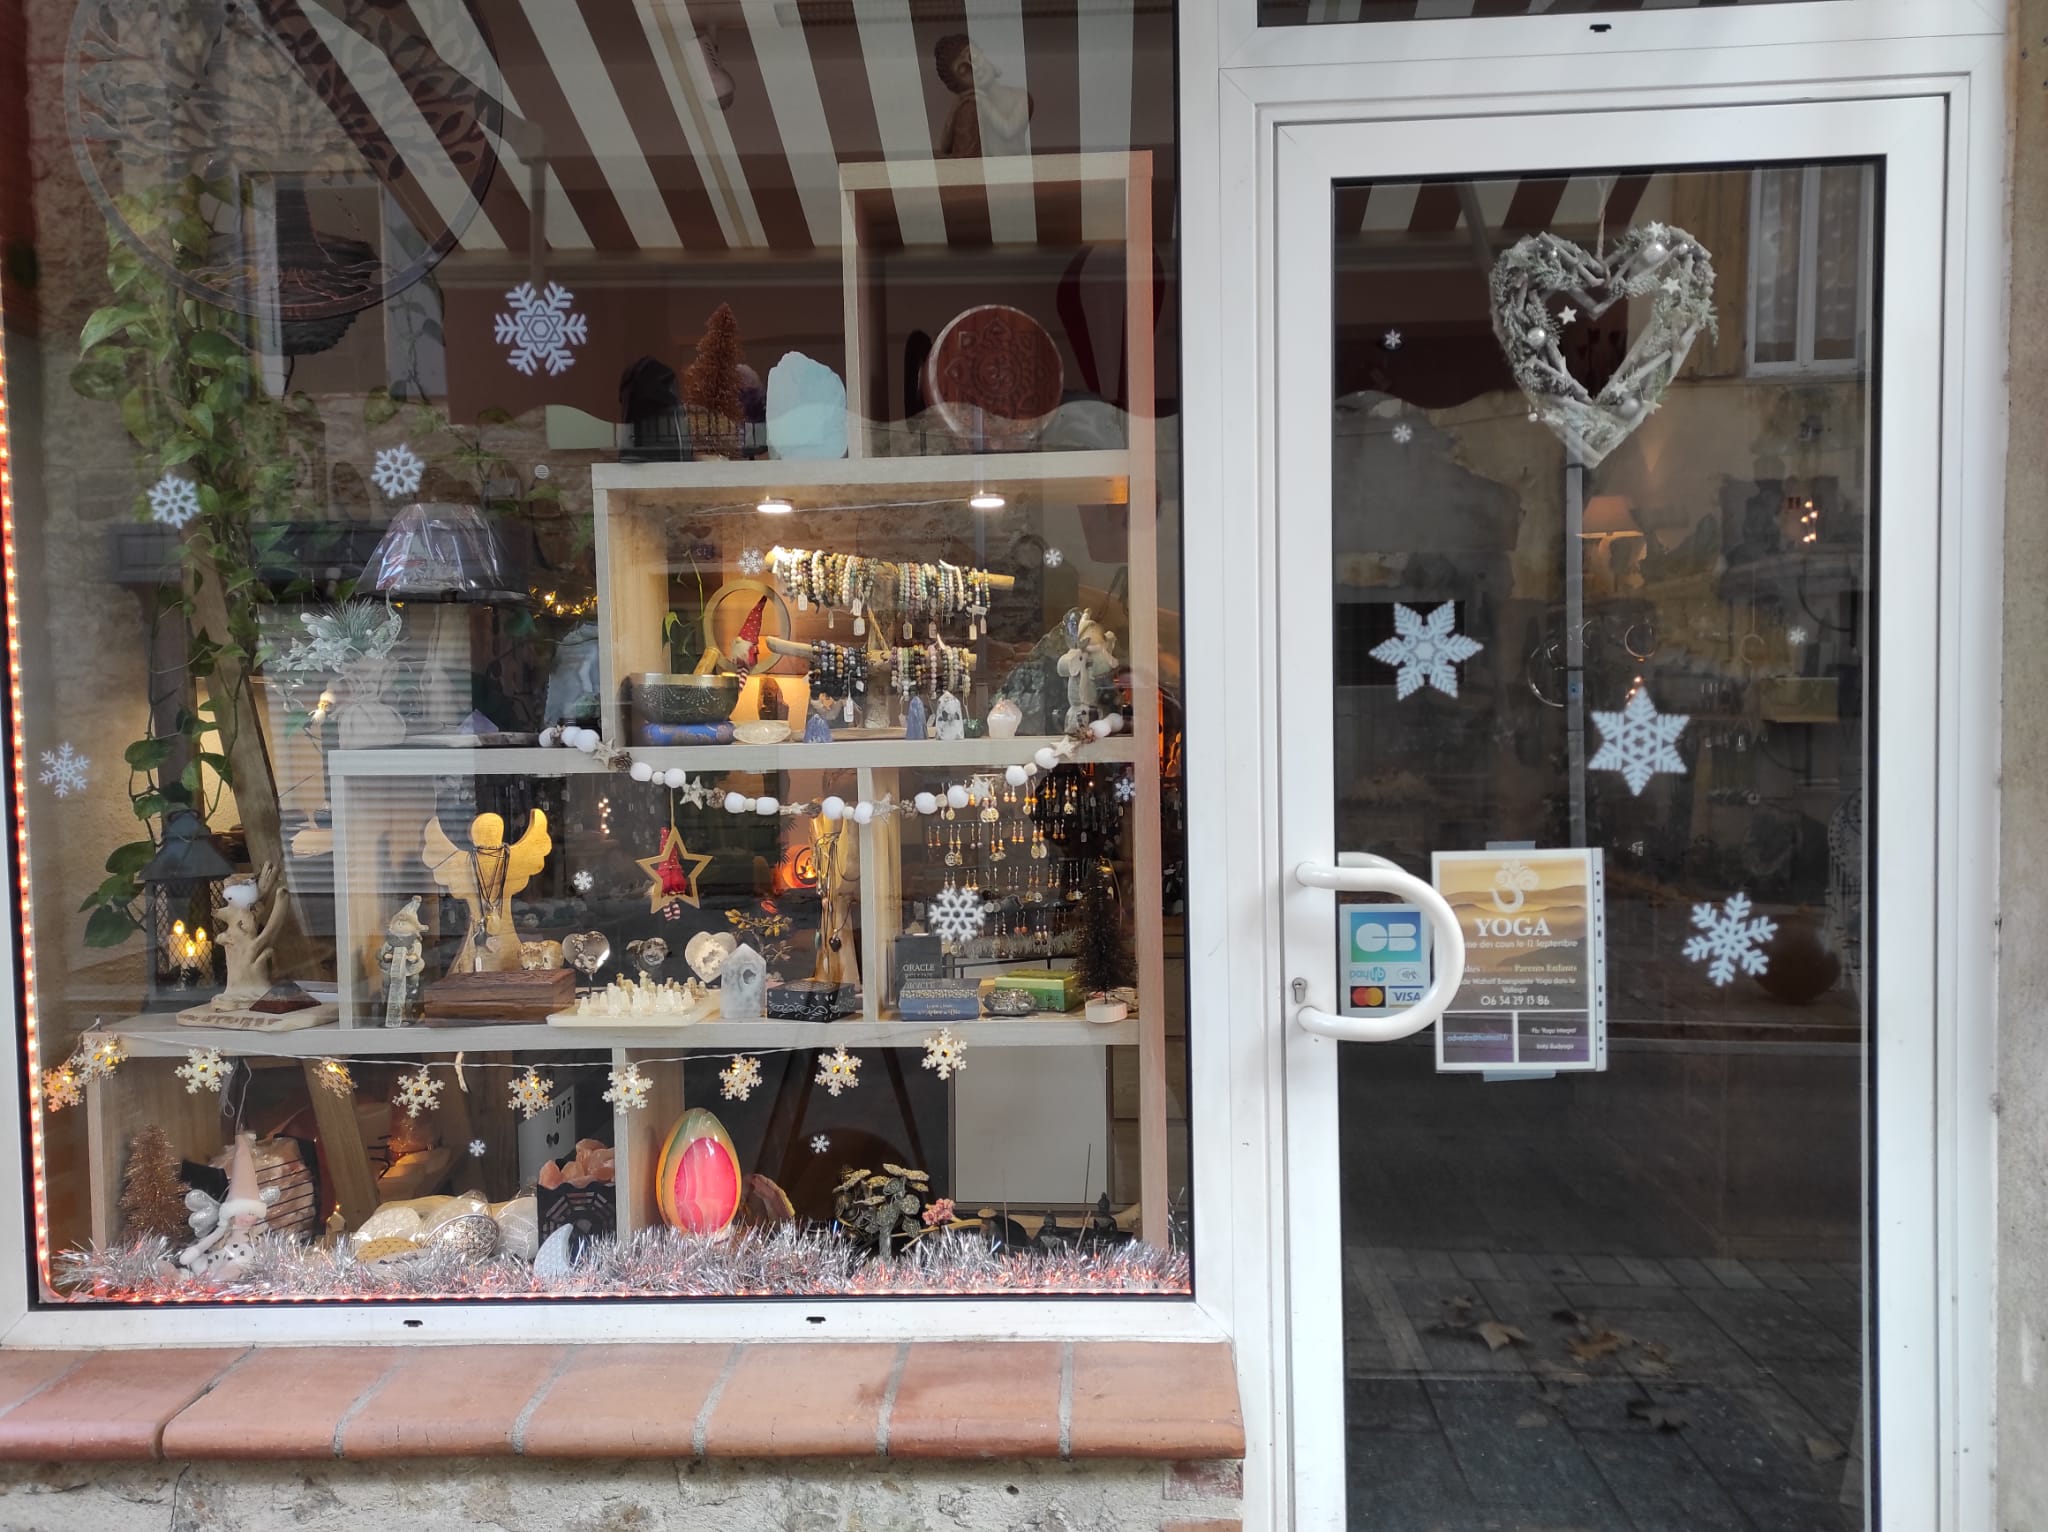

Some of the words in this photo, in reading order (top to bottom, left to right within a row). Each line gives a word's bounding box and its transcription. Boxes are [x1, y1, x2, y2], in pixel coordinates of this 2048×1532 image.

[1474, 918, 1552, 937] YOGA
[1536, 939, 1578, 949] Septembre
[903, 963, 936, 972] ORACLE
[1514, 964, 1545, 973] Parents
[1546, 964, 1577, 972] Enfants
[1393, 991, 1422, 1001] VISA
